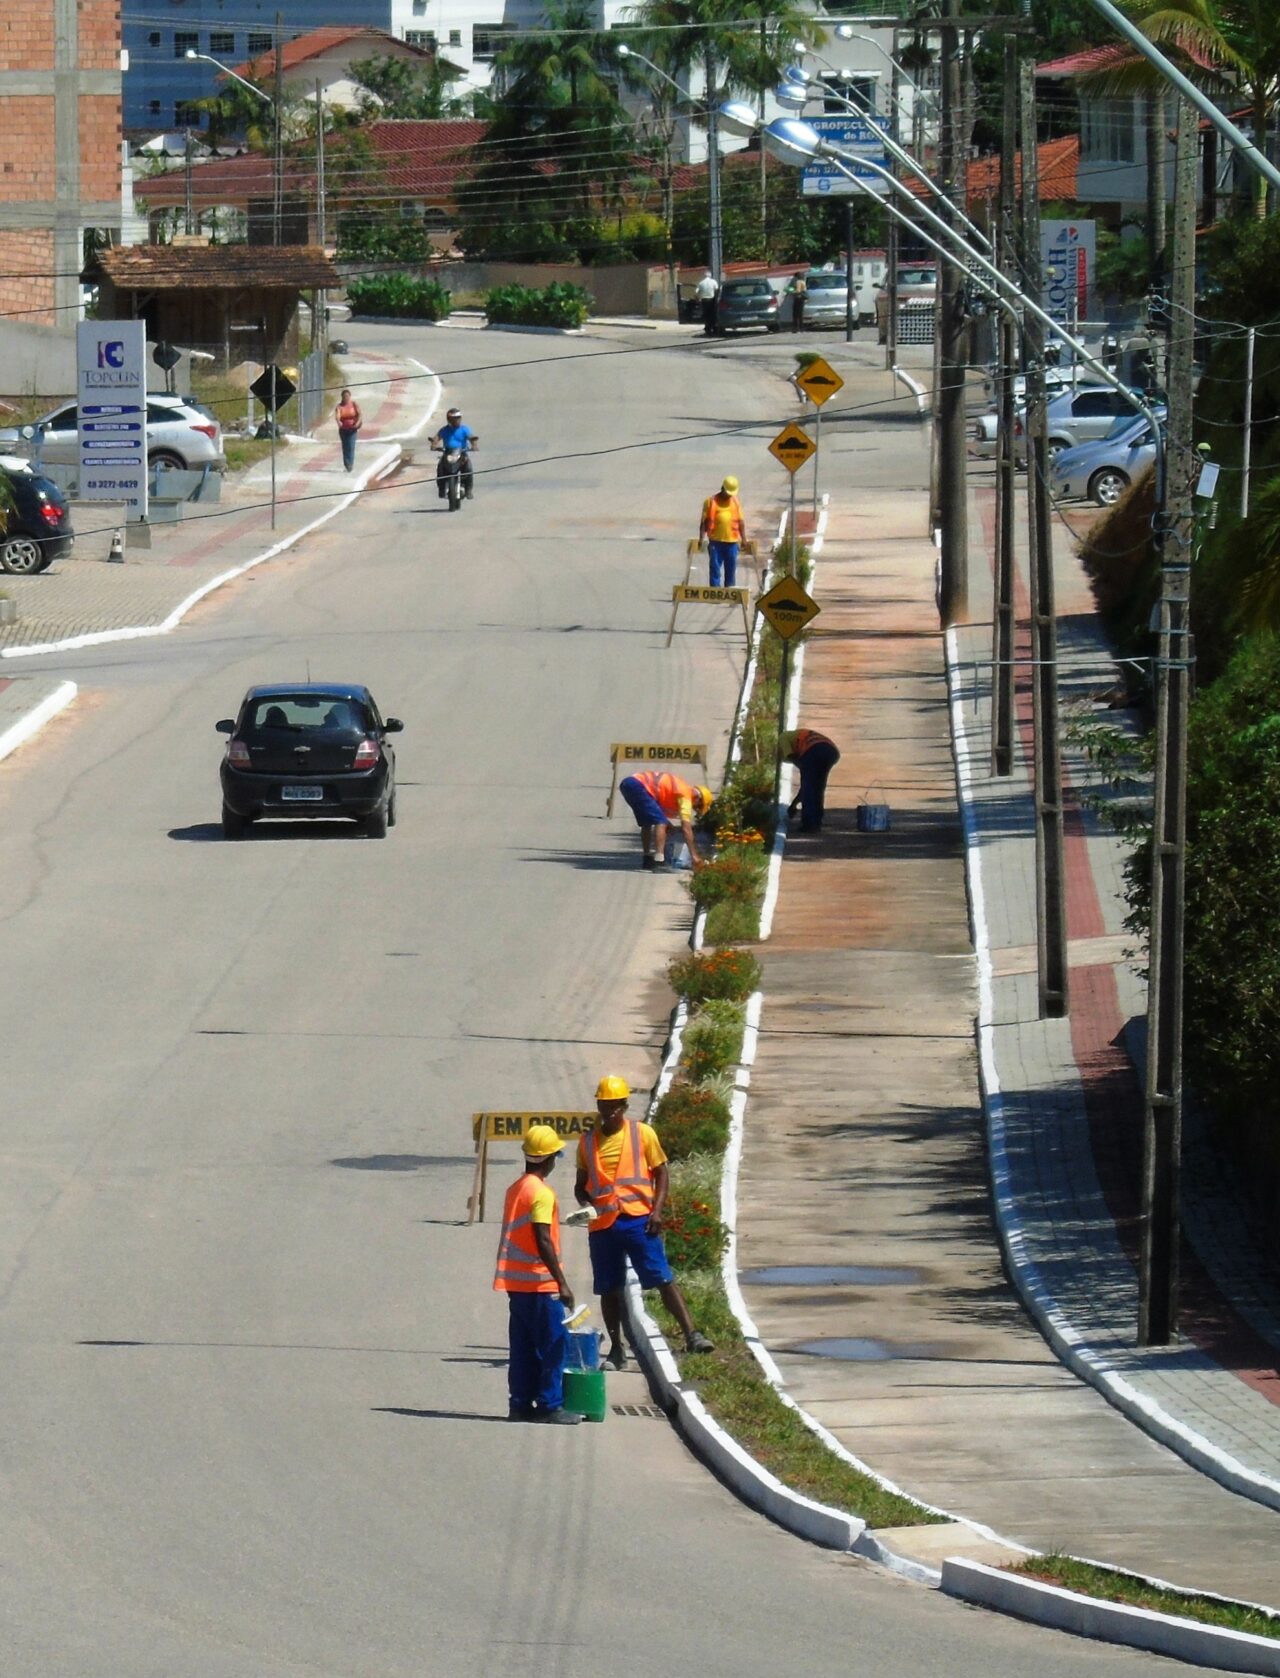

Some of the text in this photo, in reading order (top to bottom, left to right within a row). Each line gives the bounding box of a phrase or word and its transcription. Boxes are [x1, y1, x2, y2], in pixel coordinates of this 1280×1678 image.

[684, 589, 737, 601] EM OBRAS
[774, 612, 802, 622] 100m
[624, 746, 691, 760] EM OBRAS
[494, 1117, 522, 1135] EM
